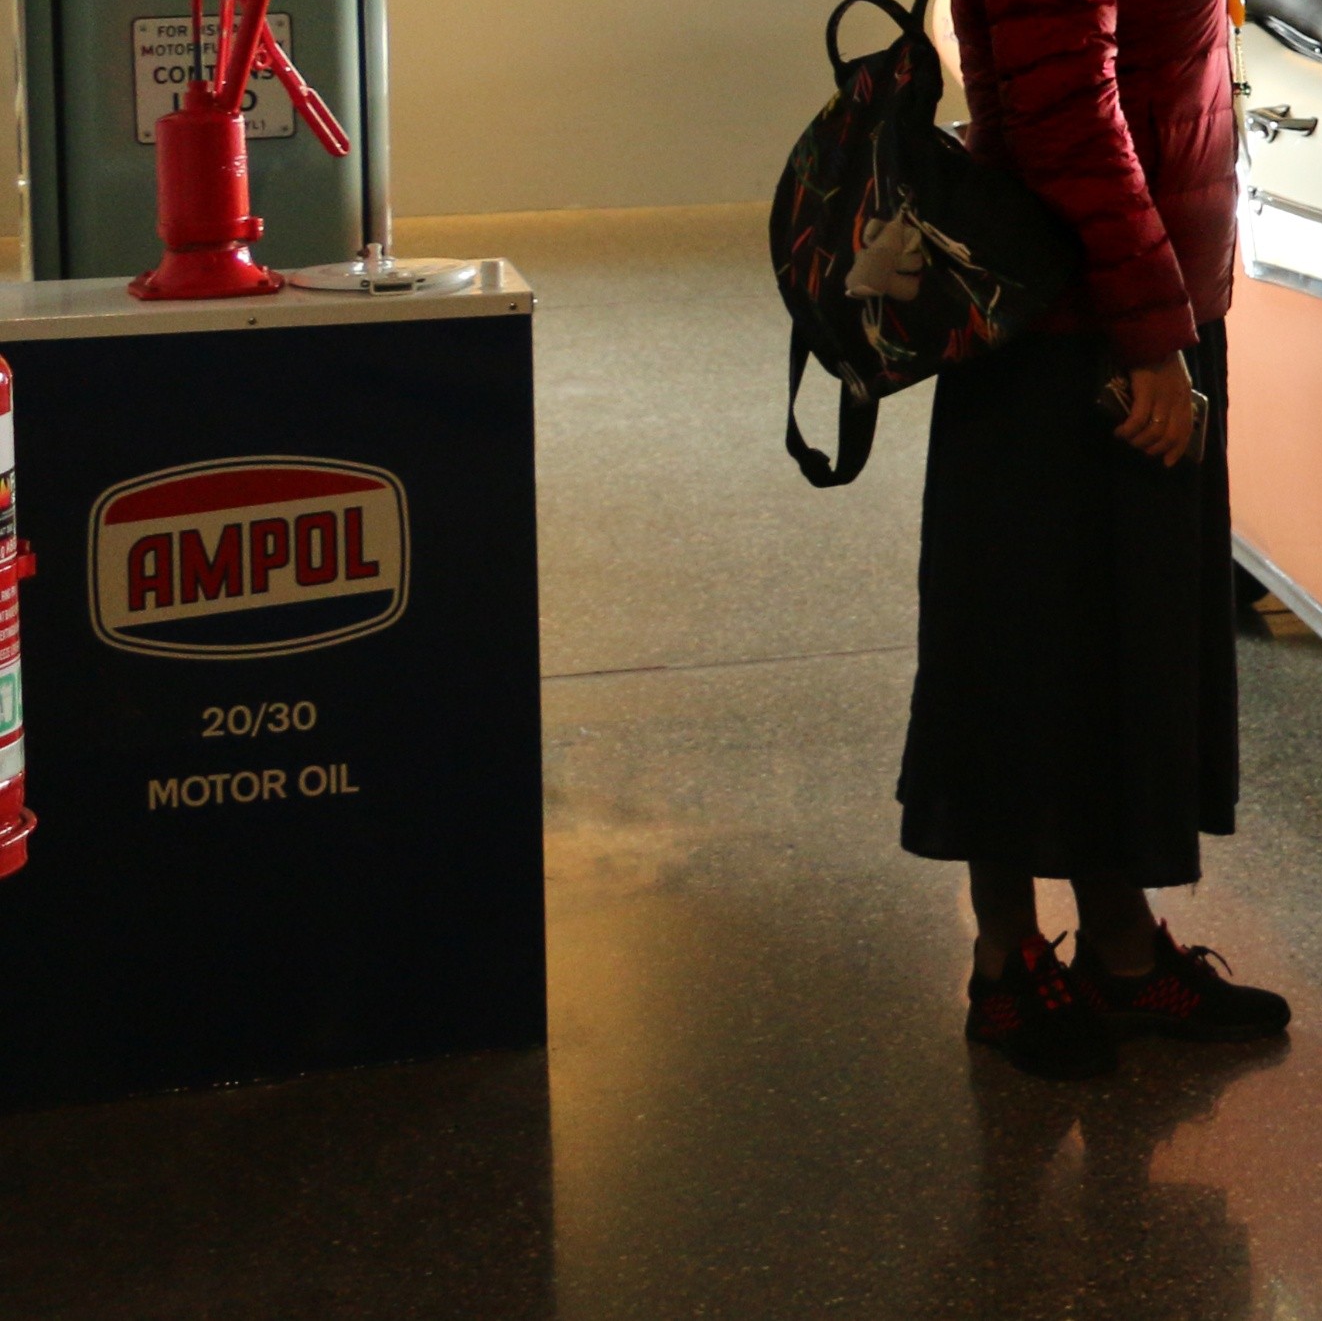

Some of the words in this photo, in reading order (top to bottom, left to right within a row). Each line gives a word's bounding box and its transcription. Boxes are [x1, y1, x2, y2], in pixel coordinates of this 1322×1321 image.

[157, 25, 187, 38] FOR
[126, 506, 381, 613] AMPOL
[201, 700, 318, 739] 20/30
[147, 768, 287, 811] MOTOR
[299, 762, 361, 797] OIL
